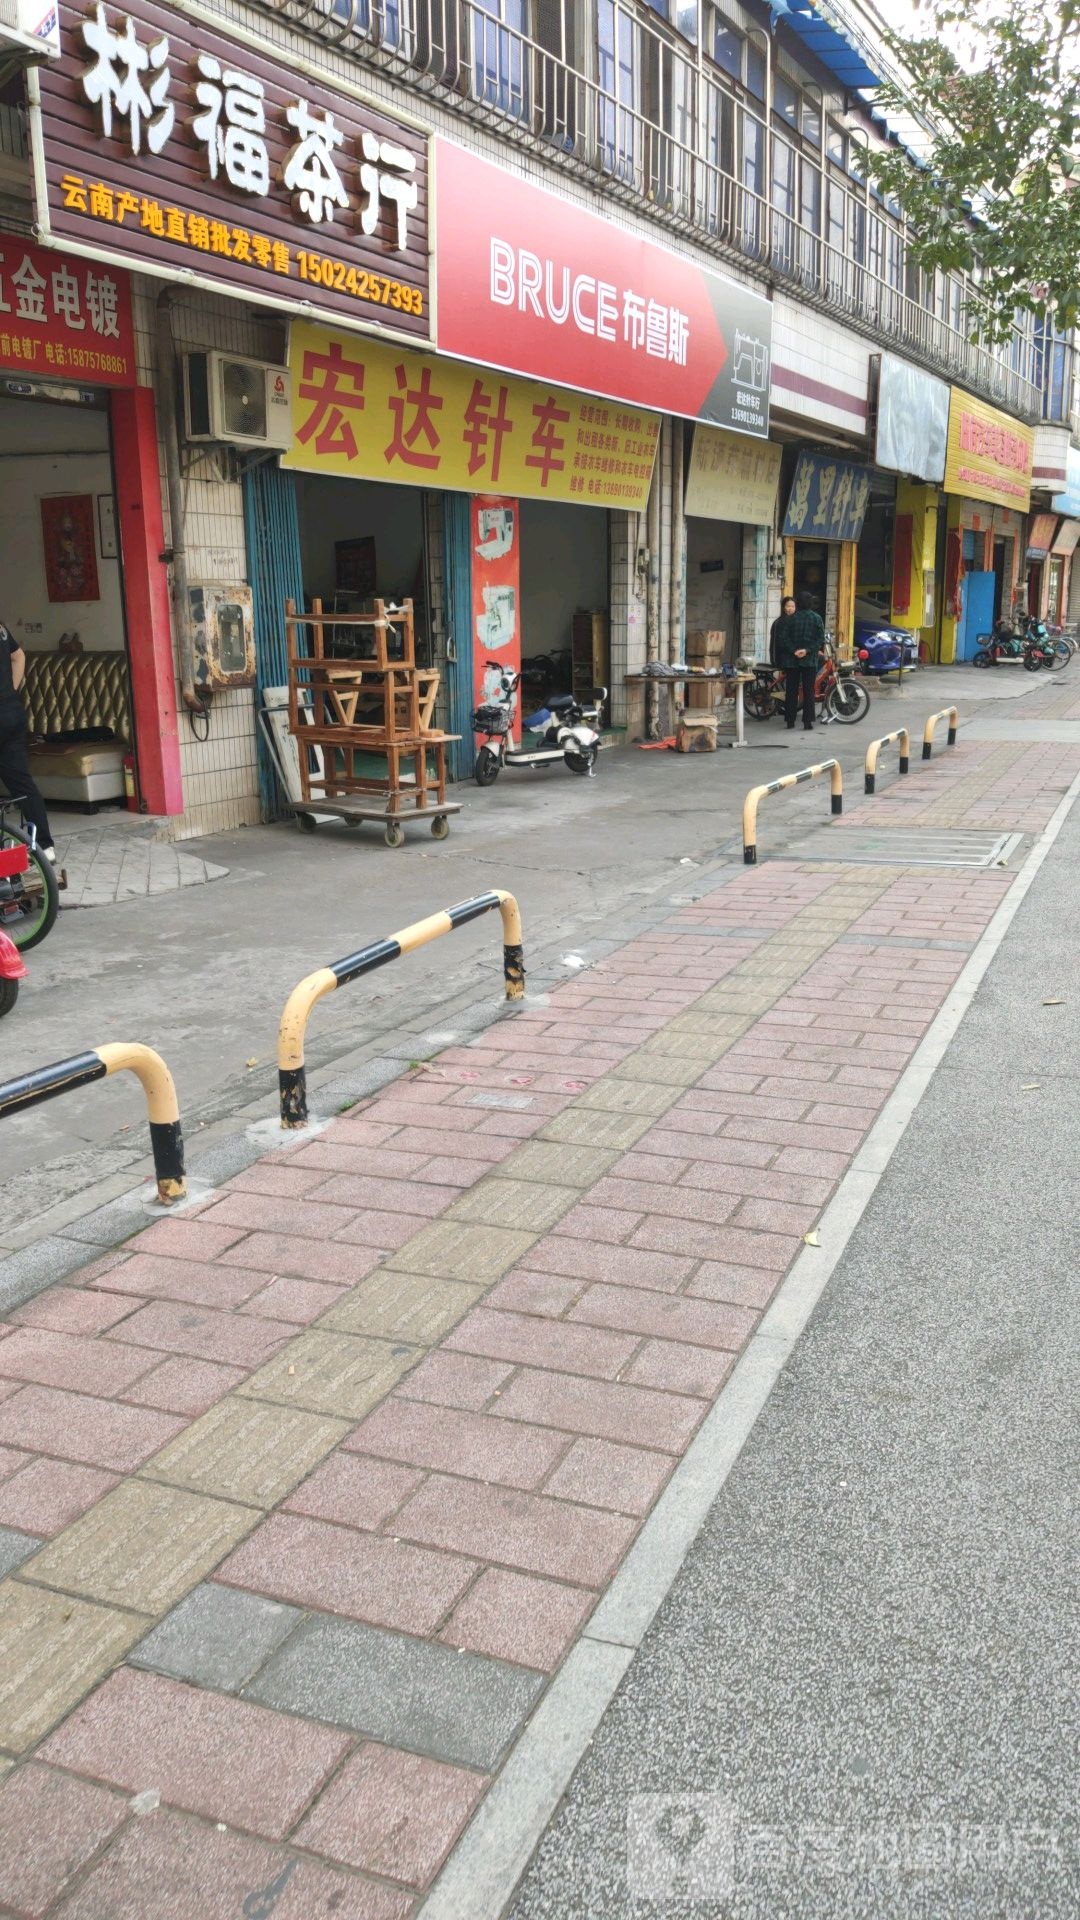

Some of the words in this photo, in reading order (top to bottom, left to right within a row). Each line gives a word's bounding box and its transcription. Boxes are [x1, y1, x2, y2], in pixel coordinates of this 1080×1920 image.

[82, 2, 417, 250] 彬福茶行
[61, 175, 290, 274] 云南产地直销批发零售
[297, 251, 423, 316] 15024257393
[490, 236, 619, 342] BRUCE
[623, 289, 690, 366] 布鲁斯
[295, 342, 570, 487] 宏达针车
